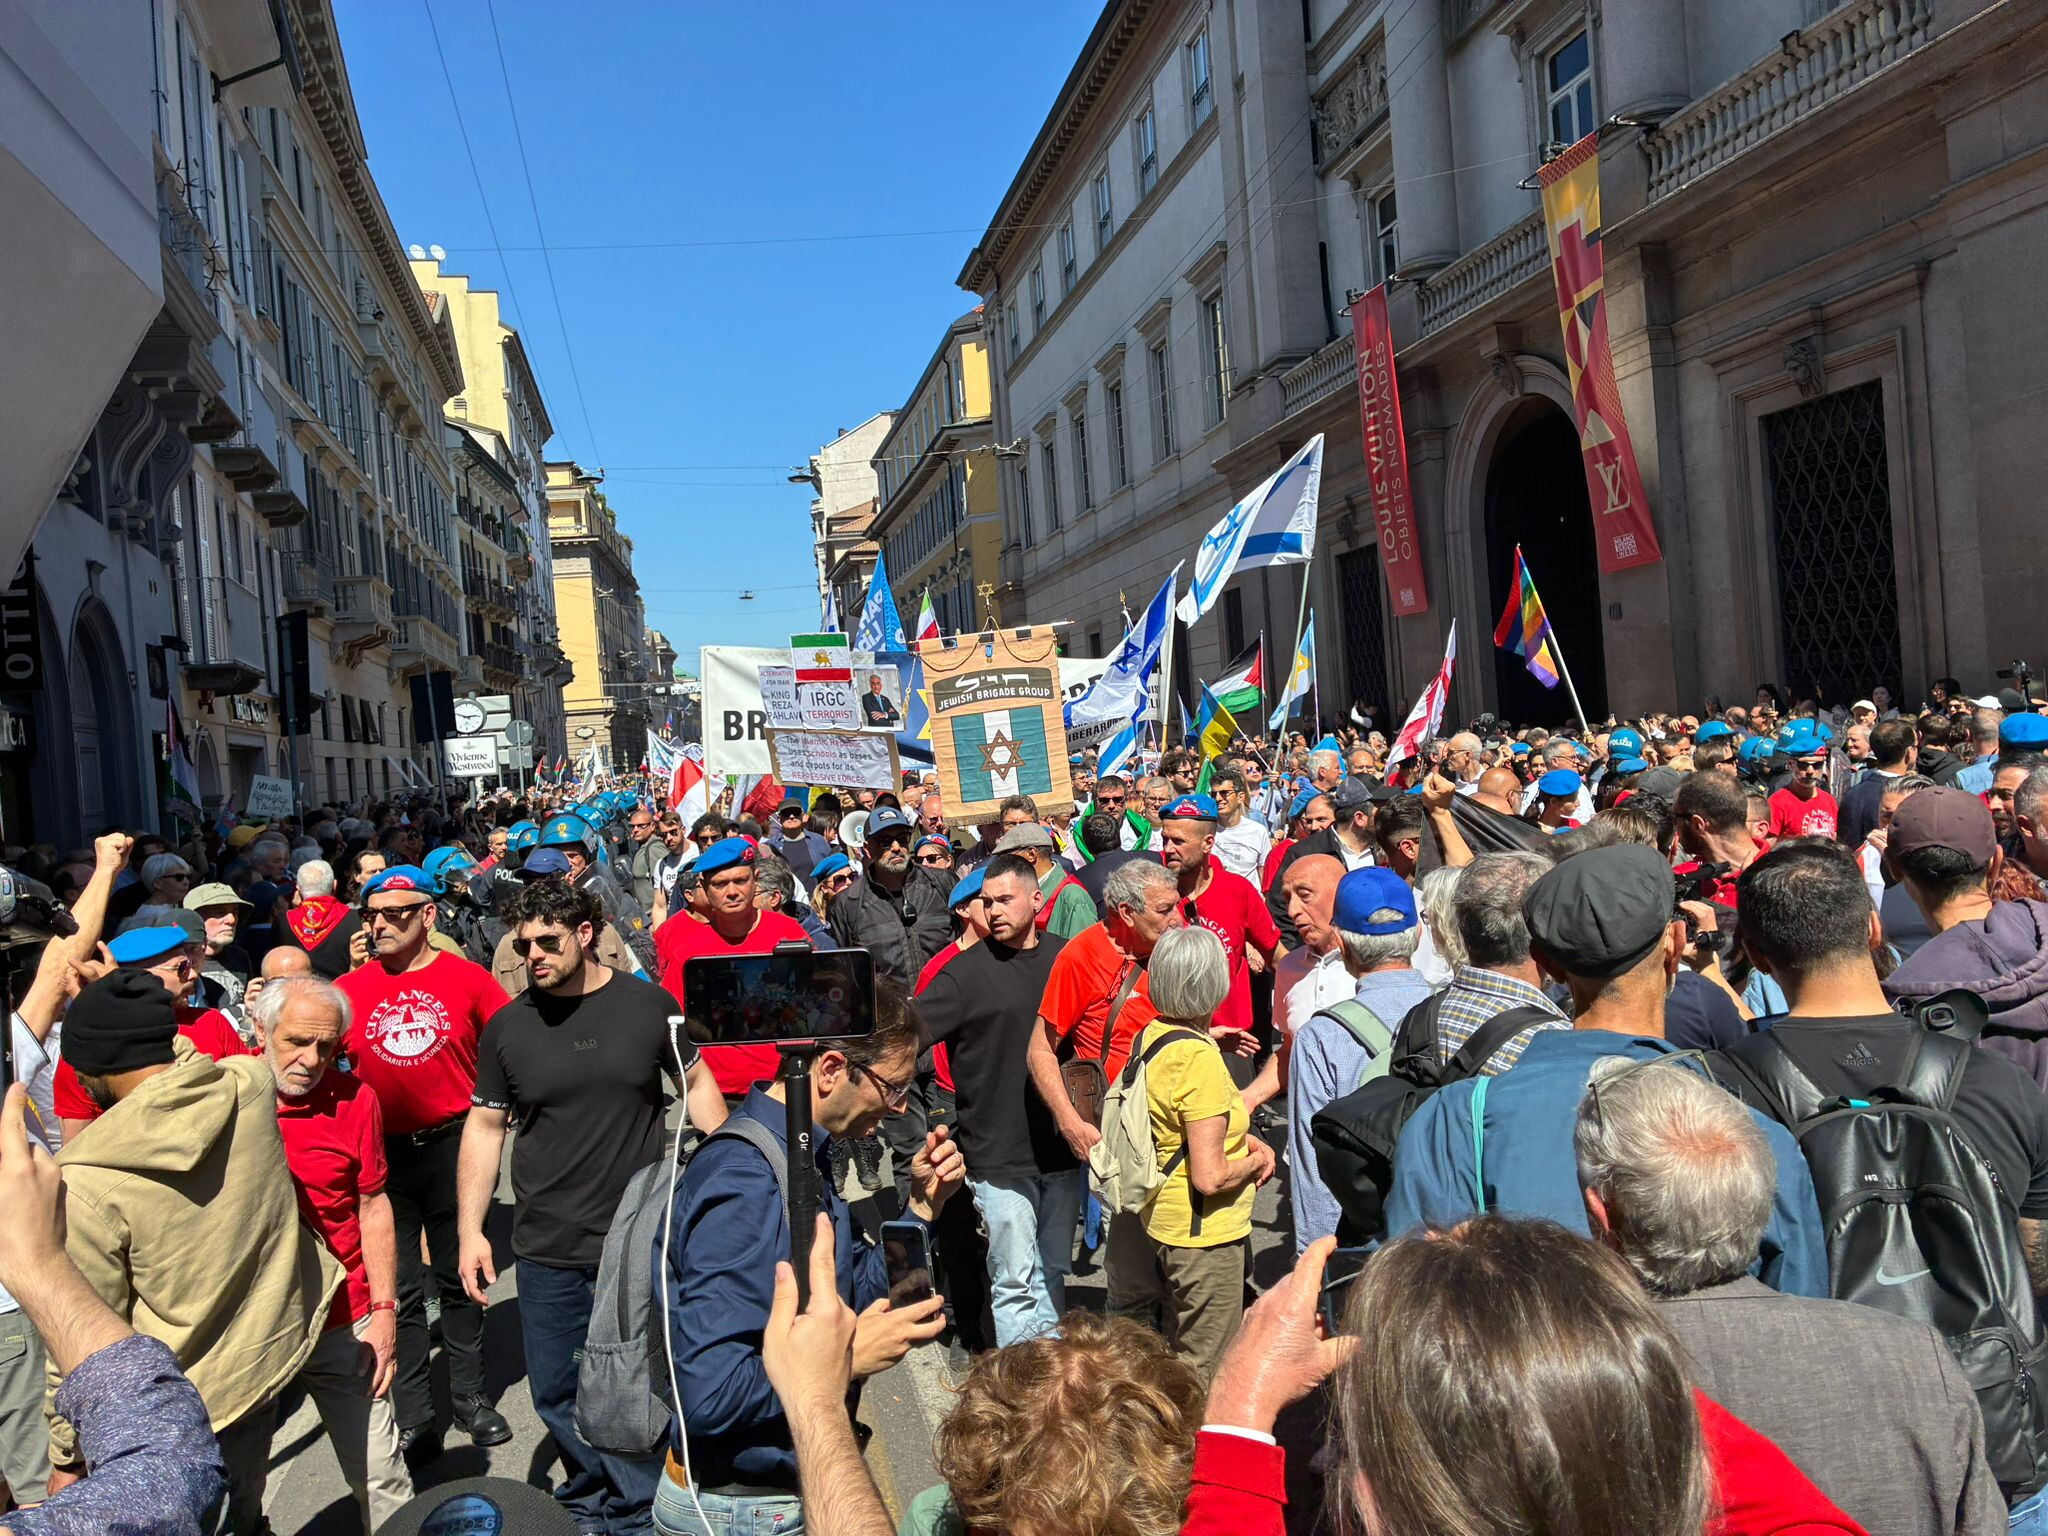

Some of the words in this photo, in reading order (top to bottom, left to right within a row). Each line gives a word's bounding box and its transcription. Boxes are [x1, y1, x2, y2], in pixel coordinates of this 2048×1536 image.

[1376, 341, 1399, 467] NOMADES
[1360, 349, 1386, 474] VUITTON
[1375, 481, 1399, 564] LOUIS
[1391, 476, 1412, 560] OBJETS
[770, 691, 790, 700] KING
[810, 691, 845, 707] IRGC
[938, 693, 972, 710] JEWISH
[977, 687, 1015, 700] BRIGADE
[1018, 687, 1050, 697] GROUP
[772, 701, 793, 710] REZA
[806, 710, 853, 719] TERRORIST
[786, 736, 799, 744] The
[830, 738, 862, 748] Republic
[448, 753, 487, 761] Vivienne
[807, 750, 837, 759] schools
[849, 751, 873, 760] bases
[447, 760, 494, 771] Westwood
[790, 760, 804, 768] and
[806, 761, 830, 771] depots
[832, 761, 843, 770] for
[844, 763, 855, 771] its
[792, 771, 836, 781] REPRESSIVE
[365, 998, 391, 1040] CITY
[396, 989, 451, 1031] ANGELS
[420, 1035, 449, 1064] SICUREZZA
[1841, 1056, 1880, 1067] adidas
